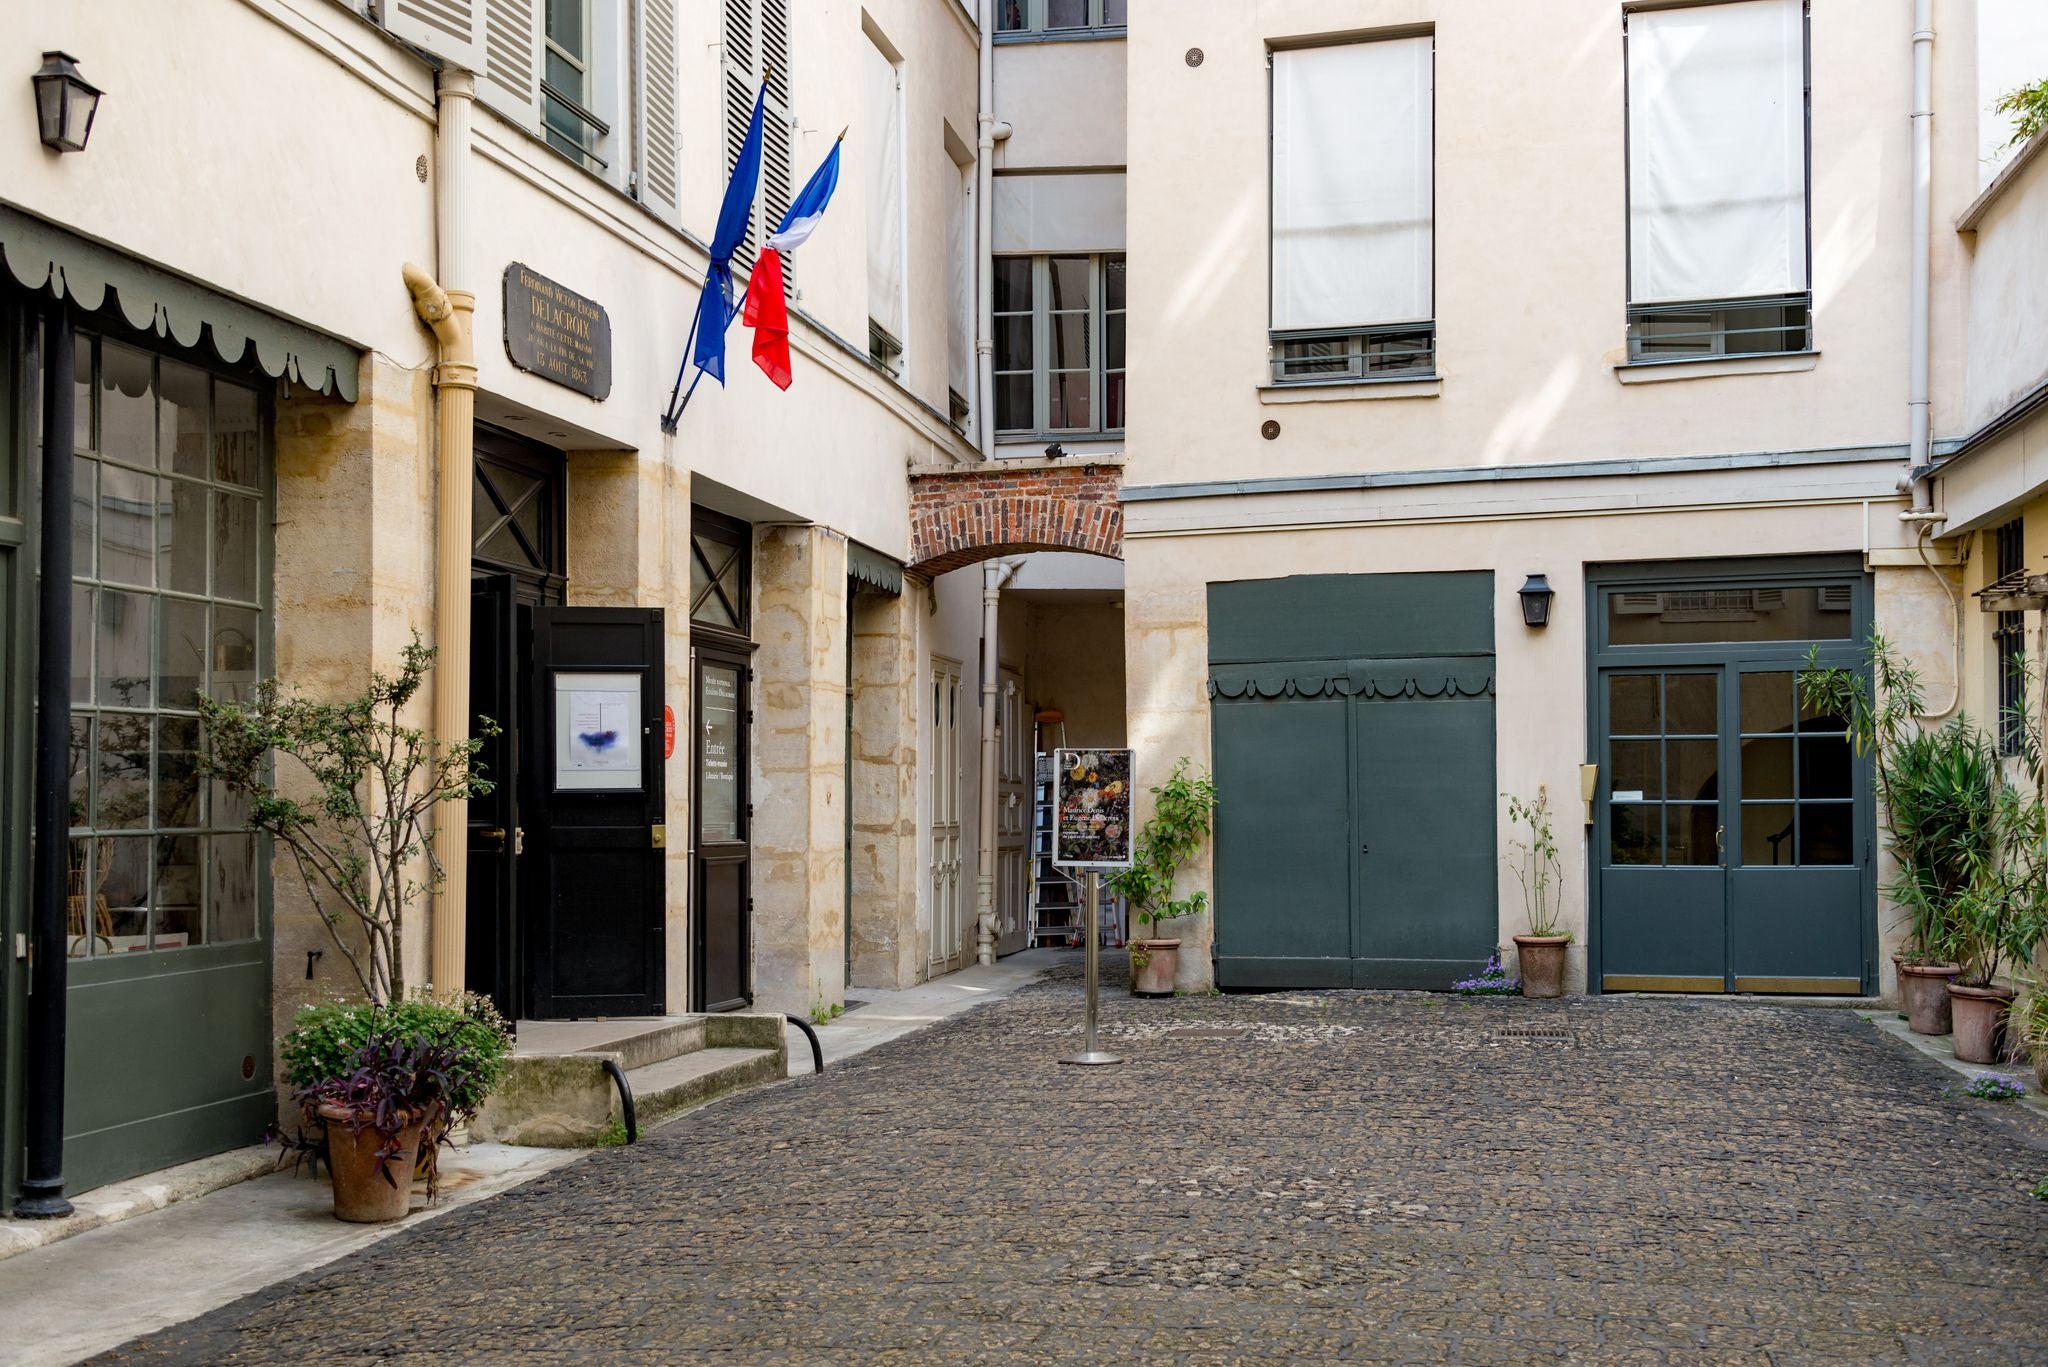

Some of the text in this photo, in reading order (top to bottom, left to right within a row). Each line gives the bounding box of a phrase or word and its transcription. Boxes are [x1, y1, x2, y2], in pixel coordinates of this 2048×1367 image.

[520, 269, 554, 299] FERDINAND
[555, 288, 576, 309] VICTOR
[531, 295, 591, 341] DELACROIX
[705, 739, 725, 755] Entrée
[1063, 805, 1105, 814] Maurice Denis
